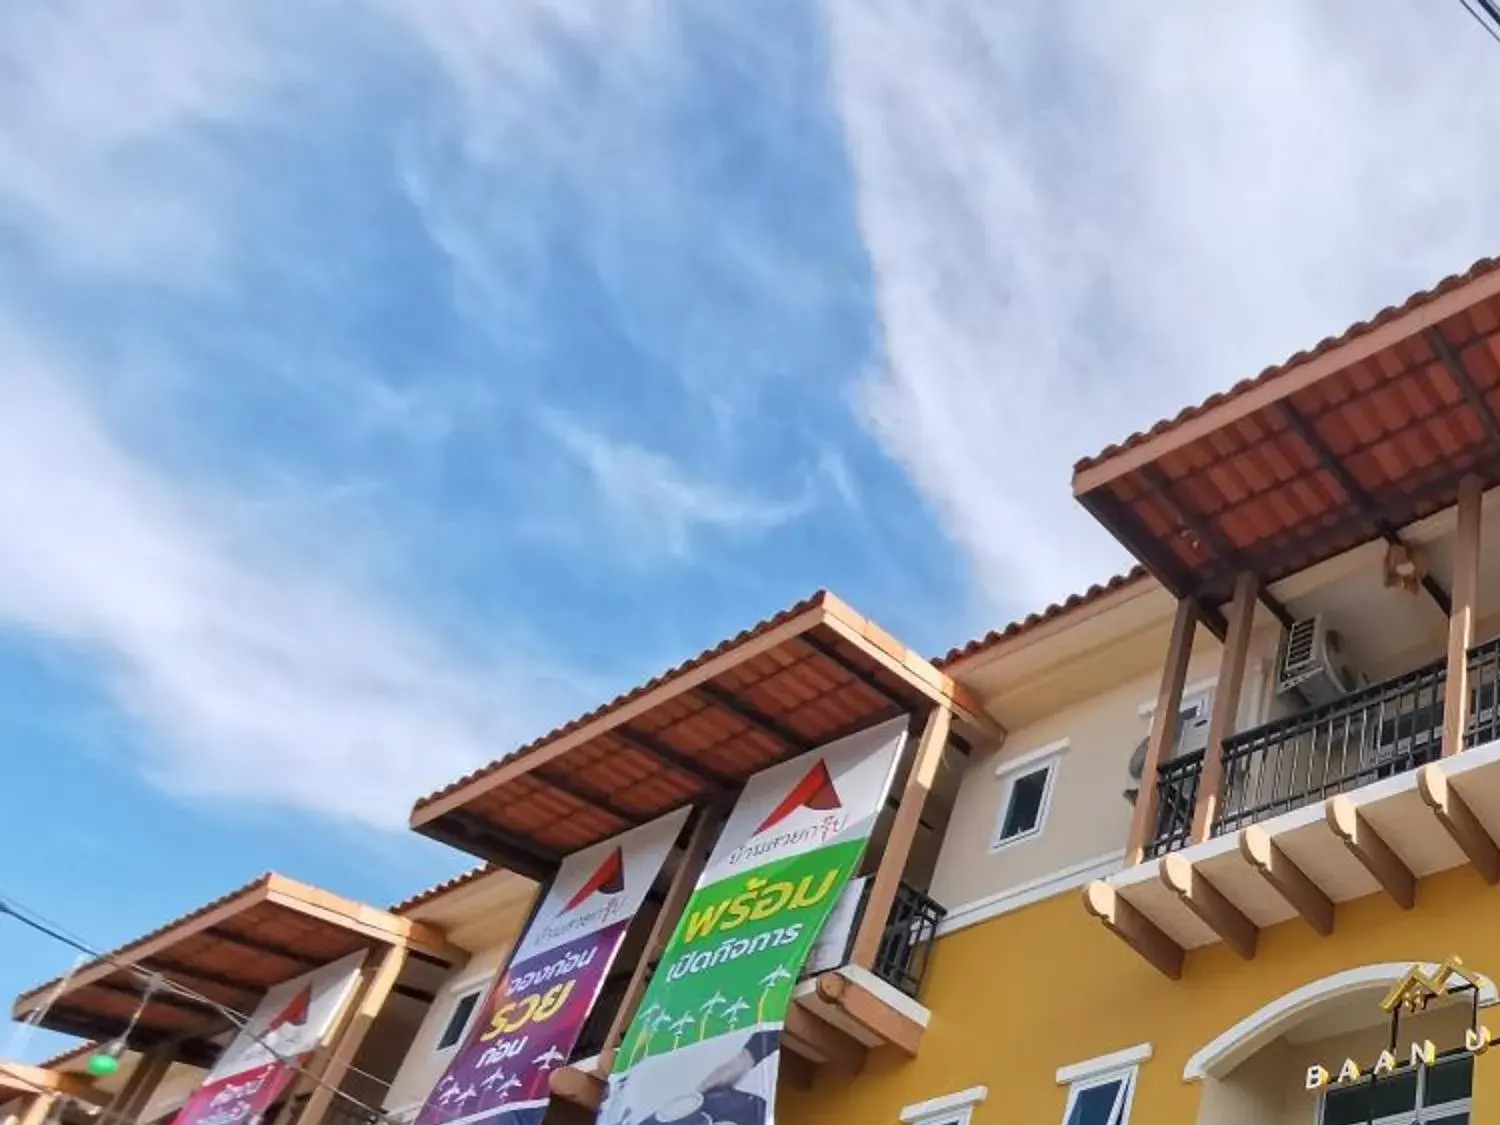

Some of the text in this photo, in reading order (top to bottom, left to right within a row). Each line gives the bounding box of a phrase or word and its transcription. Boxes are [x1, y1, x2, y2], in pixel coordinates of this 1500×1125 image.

[683, 867, 839, 944] พร้อม
[664, 922, 804, 983] เปิดกิจการ
[479, 978, 577, 1043] รวย
[475, 1034, 528, 1069] ก่อน
[1305, 1038, 1437, 1091] BAAN
